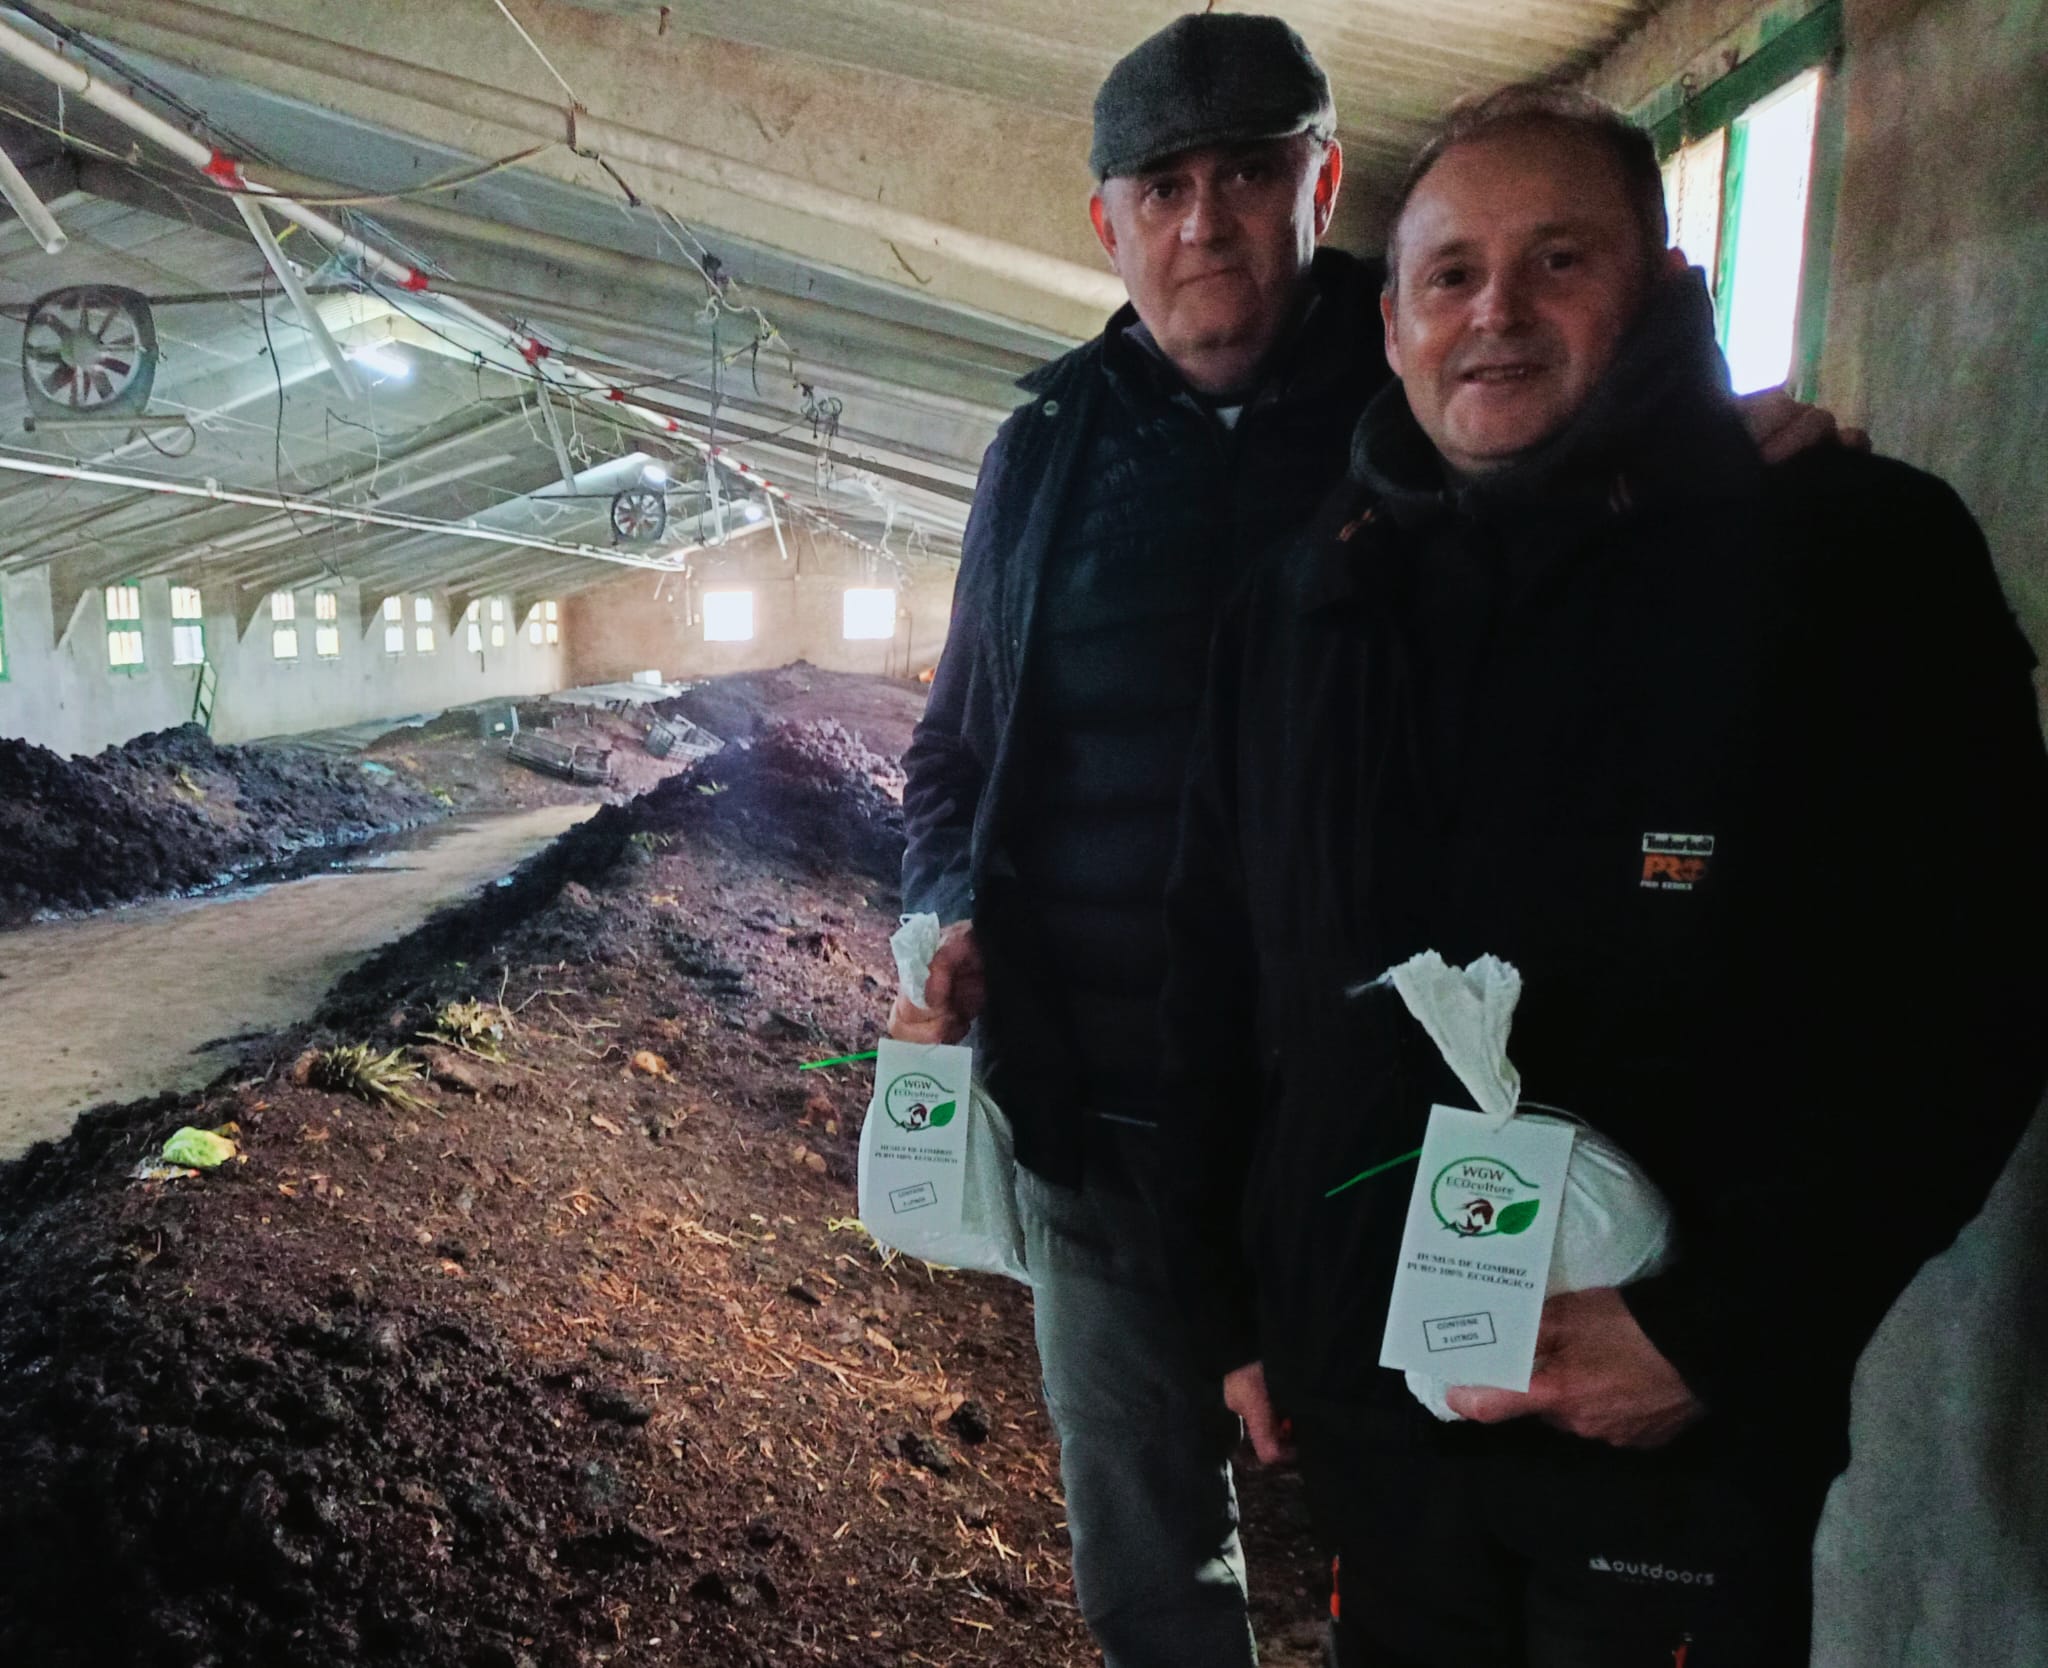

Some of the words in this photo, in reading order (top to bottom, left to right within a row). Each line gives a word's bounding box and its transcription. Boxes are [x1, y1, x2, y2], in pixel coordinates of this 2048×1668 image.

[903, 1079, 932, 1091] WGW
[1462, 1164, 1504, 1182] WGW
[1446, 1176, 1515, 1195] ECOculture
[1407, 1261, 1437, 1273] PURO
[1439, 1267, 1463, 1278] 100%
[1417, 1252, 1456, 1265] HUMUS
[1458, 1258, 1472, 1268] DE
[1476, 1261, 1528, 1277] LOMBRIZ
[1436, 1318, 1479, 1331] CONTIENE
[1450, 1332, 1479, 1344] LITROS
[1612, 1559, 1715, 1586] outdoors
